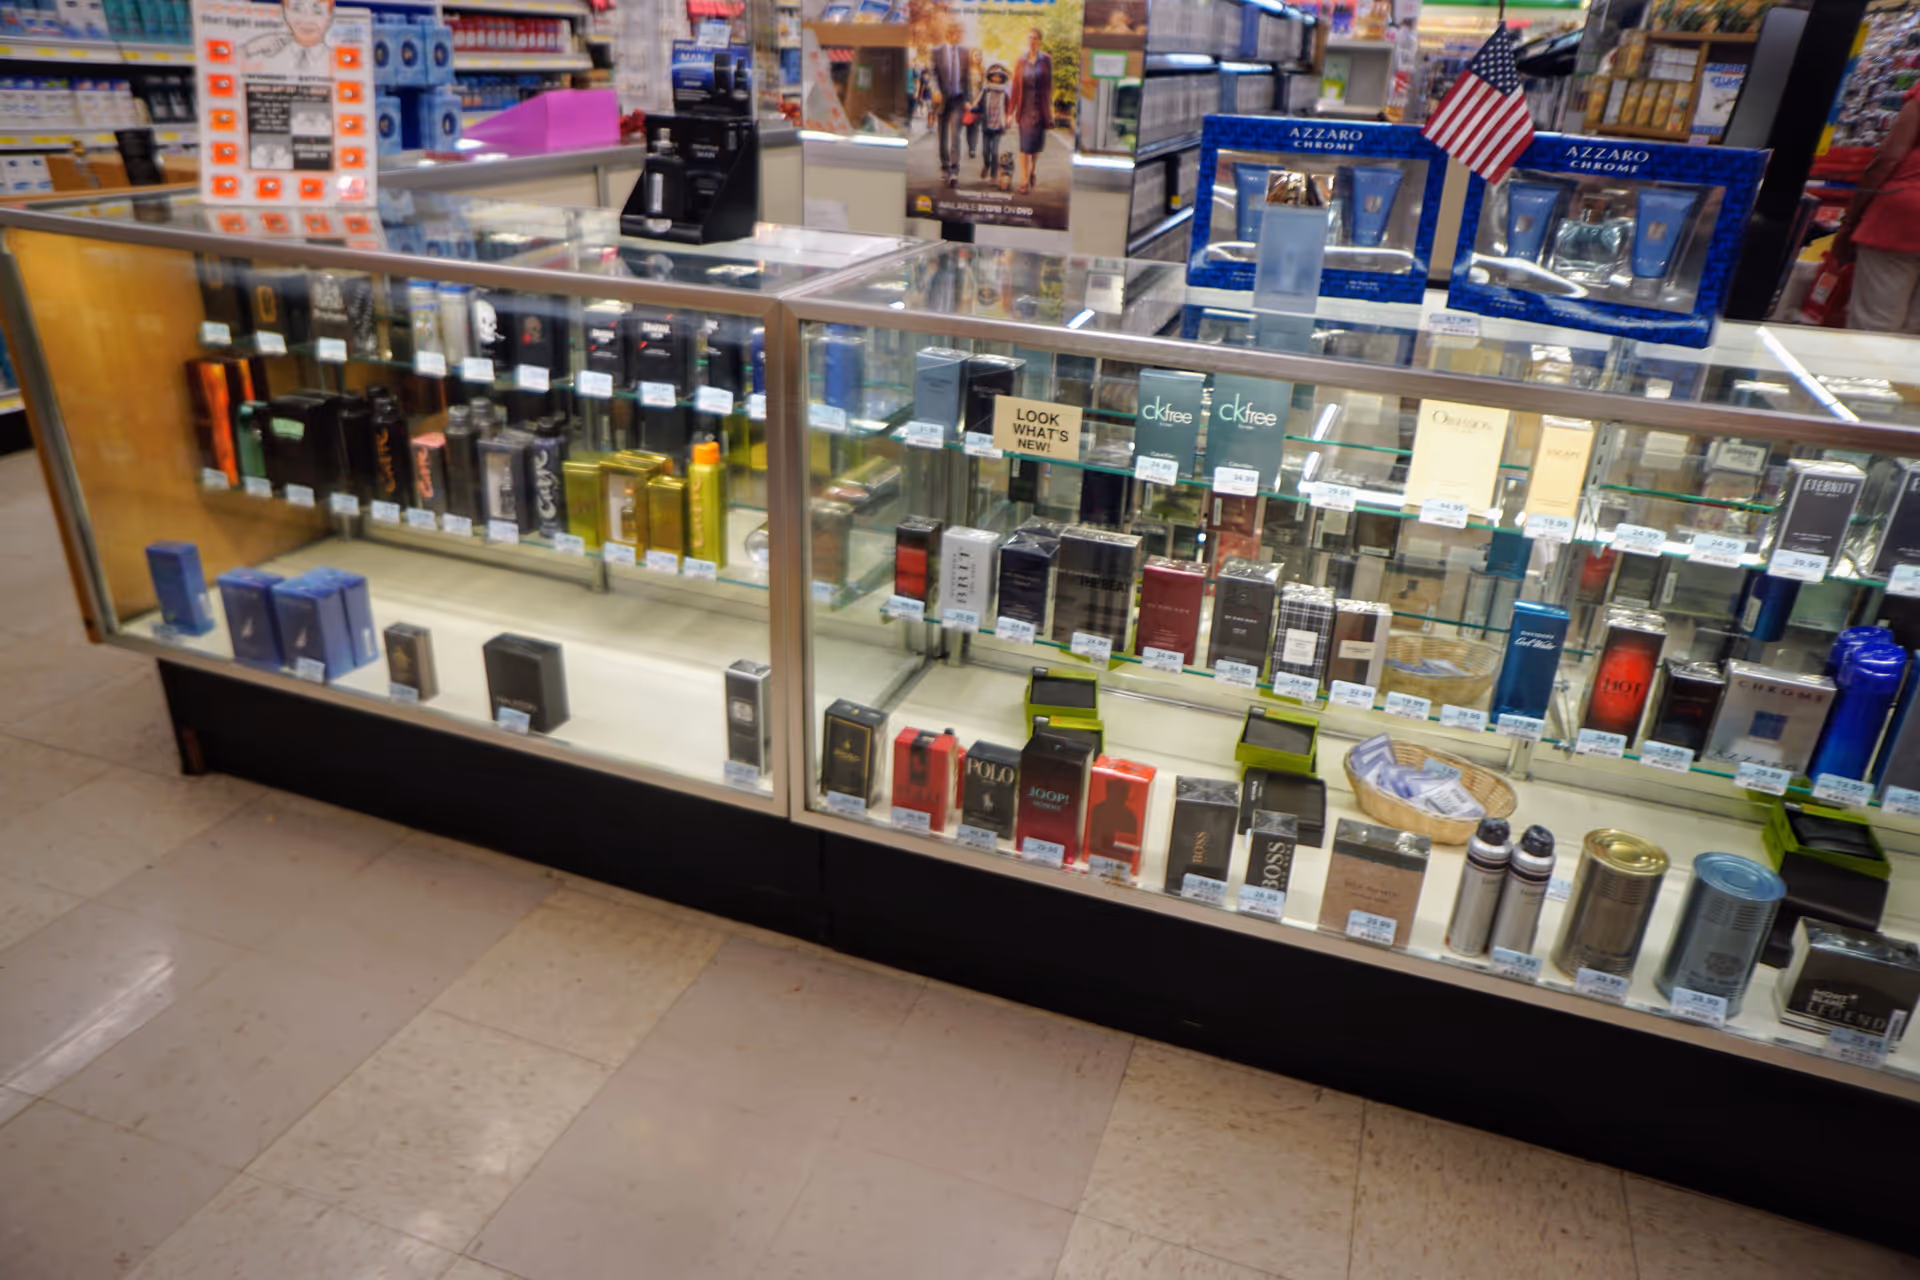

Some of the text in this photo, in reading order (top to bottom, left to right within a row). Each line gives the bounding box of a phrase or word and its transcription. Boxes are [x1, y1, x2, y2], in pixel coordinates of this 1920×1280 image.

[1290, 126, 1363, 142] AZZARO
[1293, 140, 1355, 151] CHROME
[1566, 145, 1650, 163] AZZARO
[1570, 160, 1640, 174] CHROME
[1016, 207, 1034, 216] DVD
[1016, 408, 1061, 426] LOOK
[1013, 422, 1069, 443] WHAT'S
[1017, 438, 1051, 453] NEW!
[1803, 477, 1855, 495] ETERNITY
[1602, 677, 1643, 699] HOT
[1737, 679, 1827, 703] CHROME
[967, 757, 1014, 784] POLO
[1027, 785, 1069, 805] JOOP!
[1261, 841, 1286, 889] BOSS
[1806, 1001, 1888, 1029] LEGEND
